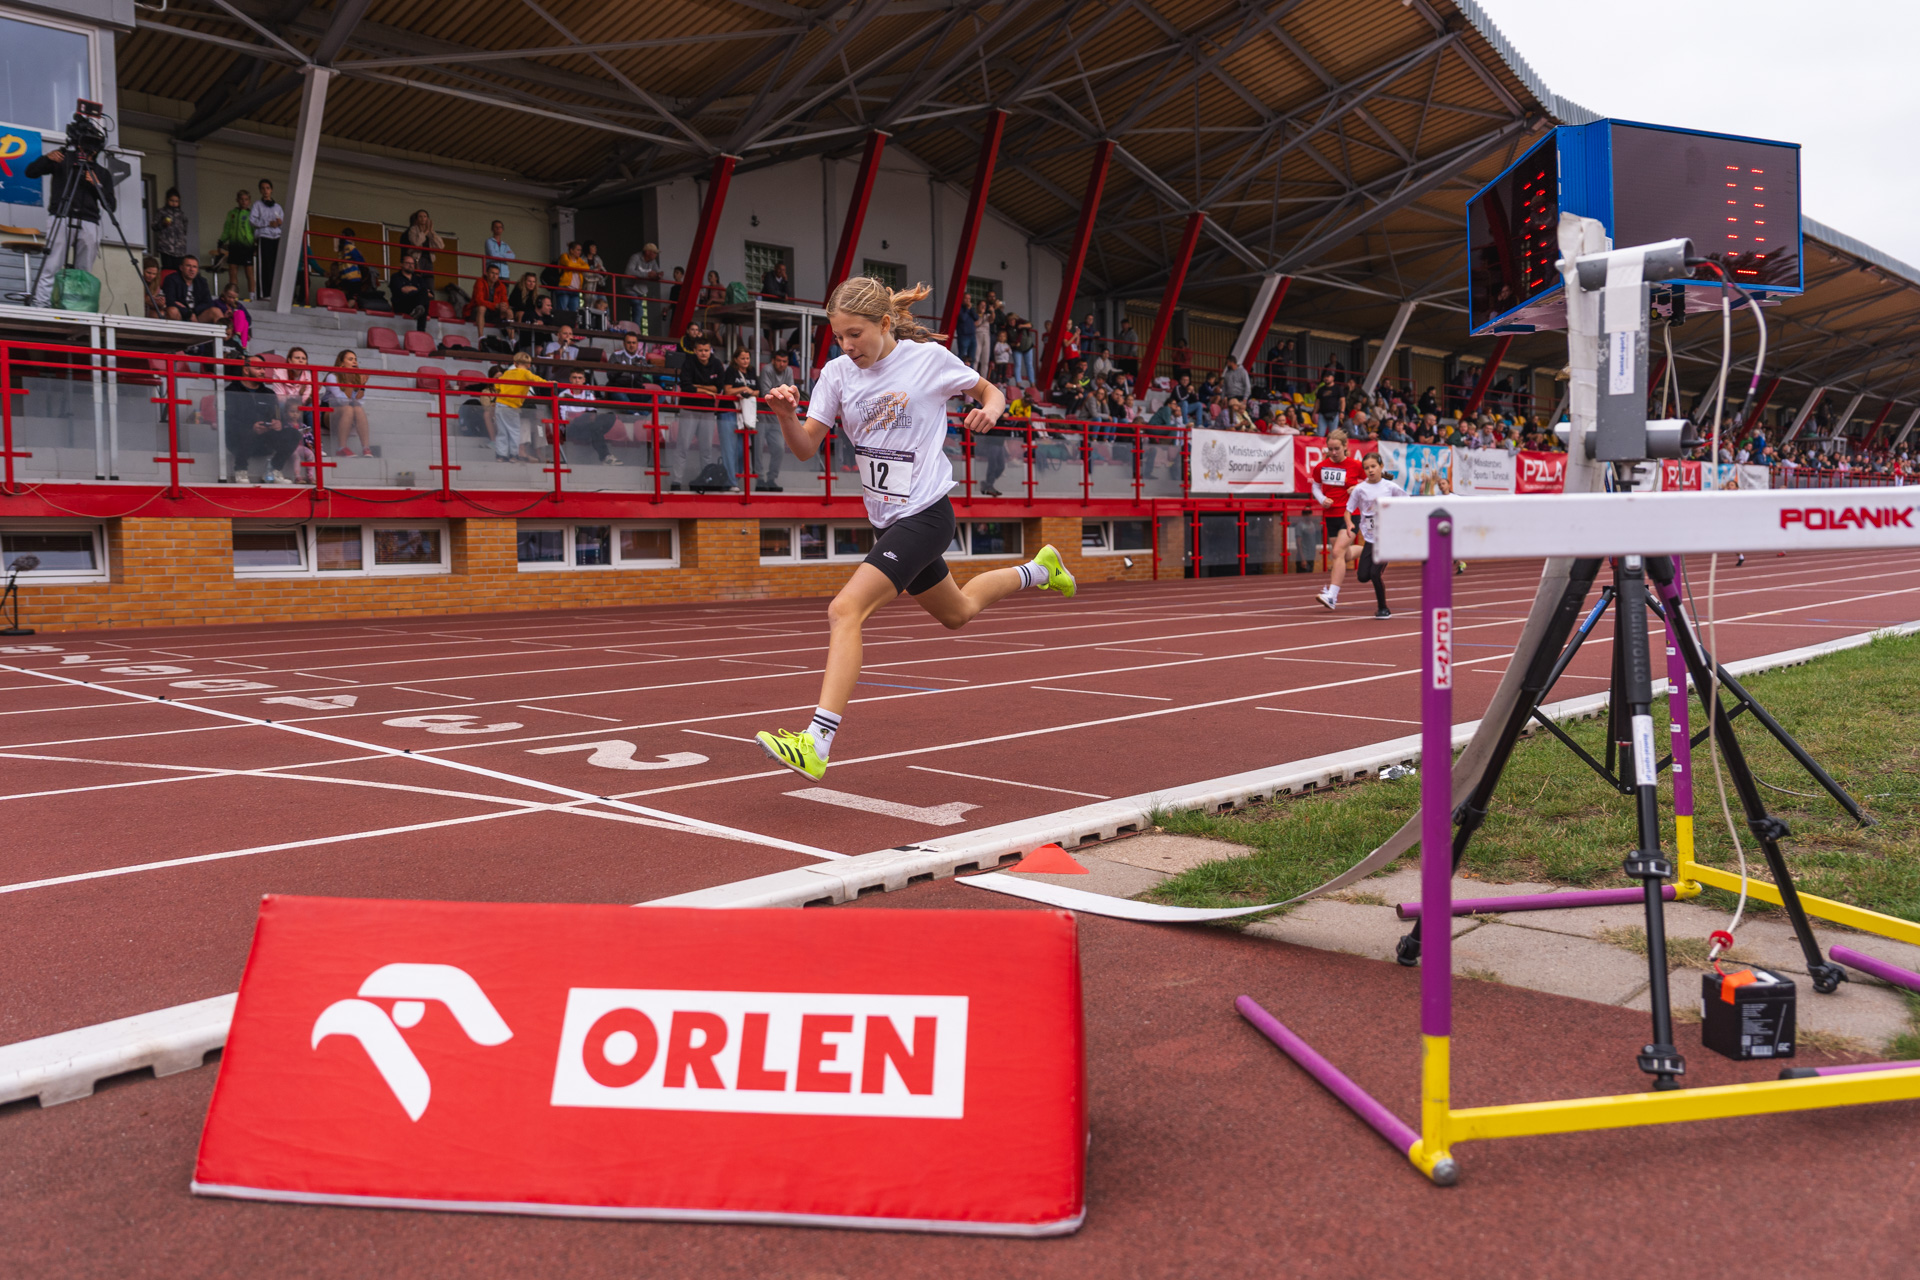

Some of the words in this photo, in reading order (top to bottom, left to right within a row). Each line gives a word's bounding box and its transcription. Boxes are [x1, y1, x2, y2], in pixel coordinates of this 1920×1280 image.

[1228, 445, 1273, 458] Ministerstwo
[869, 461, 889, 490] 12
[1228, 460, 1252, 473] Sportu
[1258, 461, 1285, 474] Turystyki
[1324, 470, 1342, 481] 350
[1524, 459, 1563, 482] PZLA
[1780, 506, 1914, 530] POLANIK
[1437, 611, 1449, 685] POLANIK
[1631, 598, 1646, 683] Manfrotto
[60, 654, 131, 664] 7
[168, 679, 279, 692] 5
[259, 694, 359, 710] 4
[381, 714, 524, 734] 3
[524, 739, 710, 770] 2
[781, 787, 984, 826] 1
[582, 1006, 938, 1096] ORLEN
